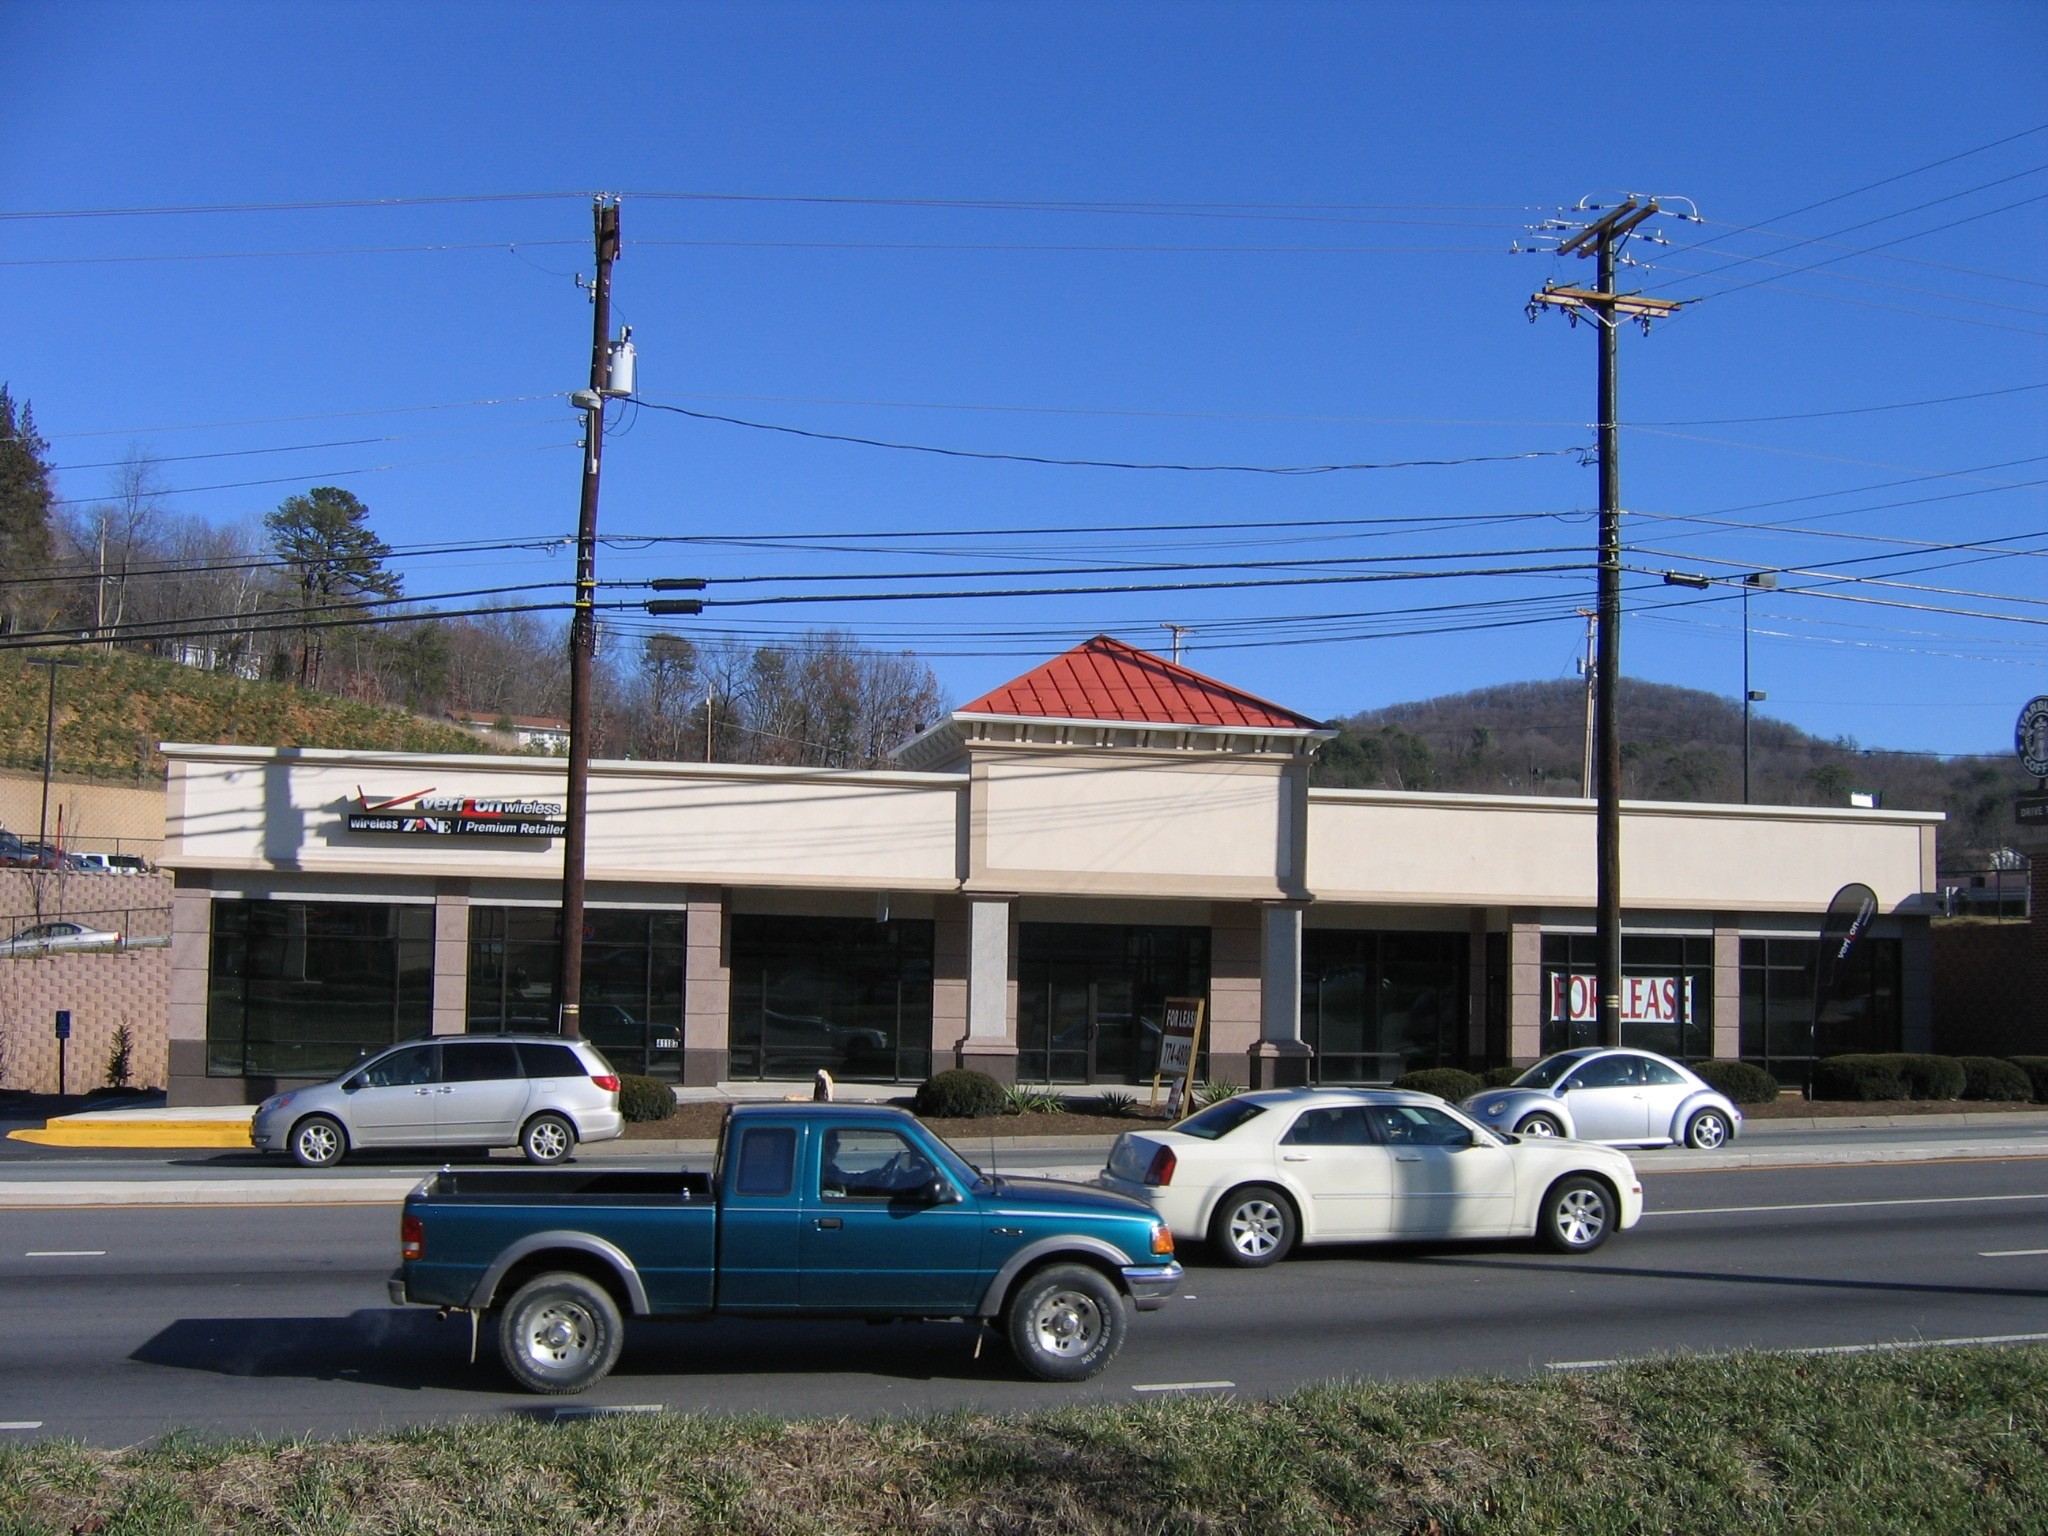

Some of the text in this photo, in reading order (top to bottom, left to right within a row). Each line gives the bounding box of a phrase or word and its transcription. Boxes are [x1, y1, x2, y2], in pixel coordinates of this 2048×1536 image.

[422, 795, 561, 817] verizon wireless
[2020, 806, 2043, 817] DRIVE
[350, 819, 399, 830] wireless
[466, 821, 517, 834] Premium
[520, 821, 566, 835] Retailer
[1166, 1009, 1179, 1027] FOR
